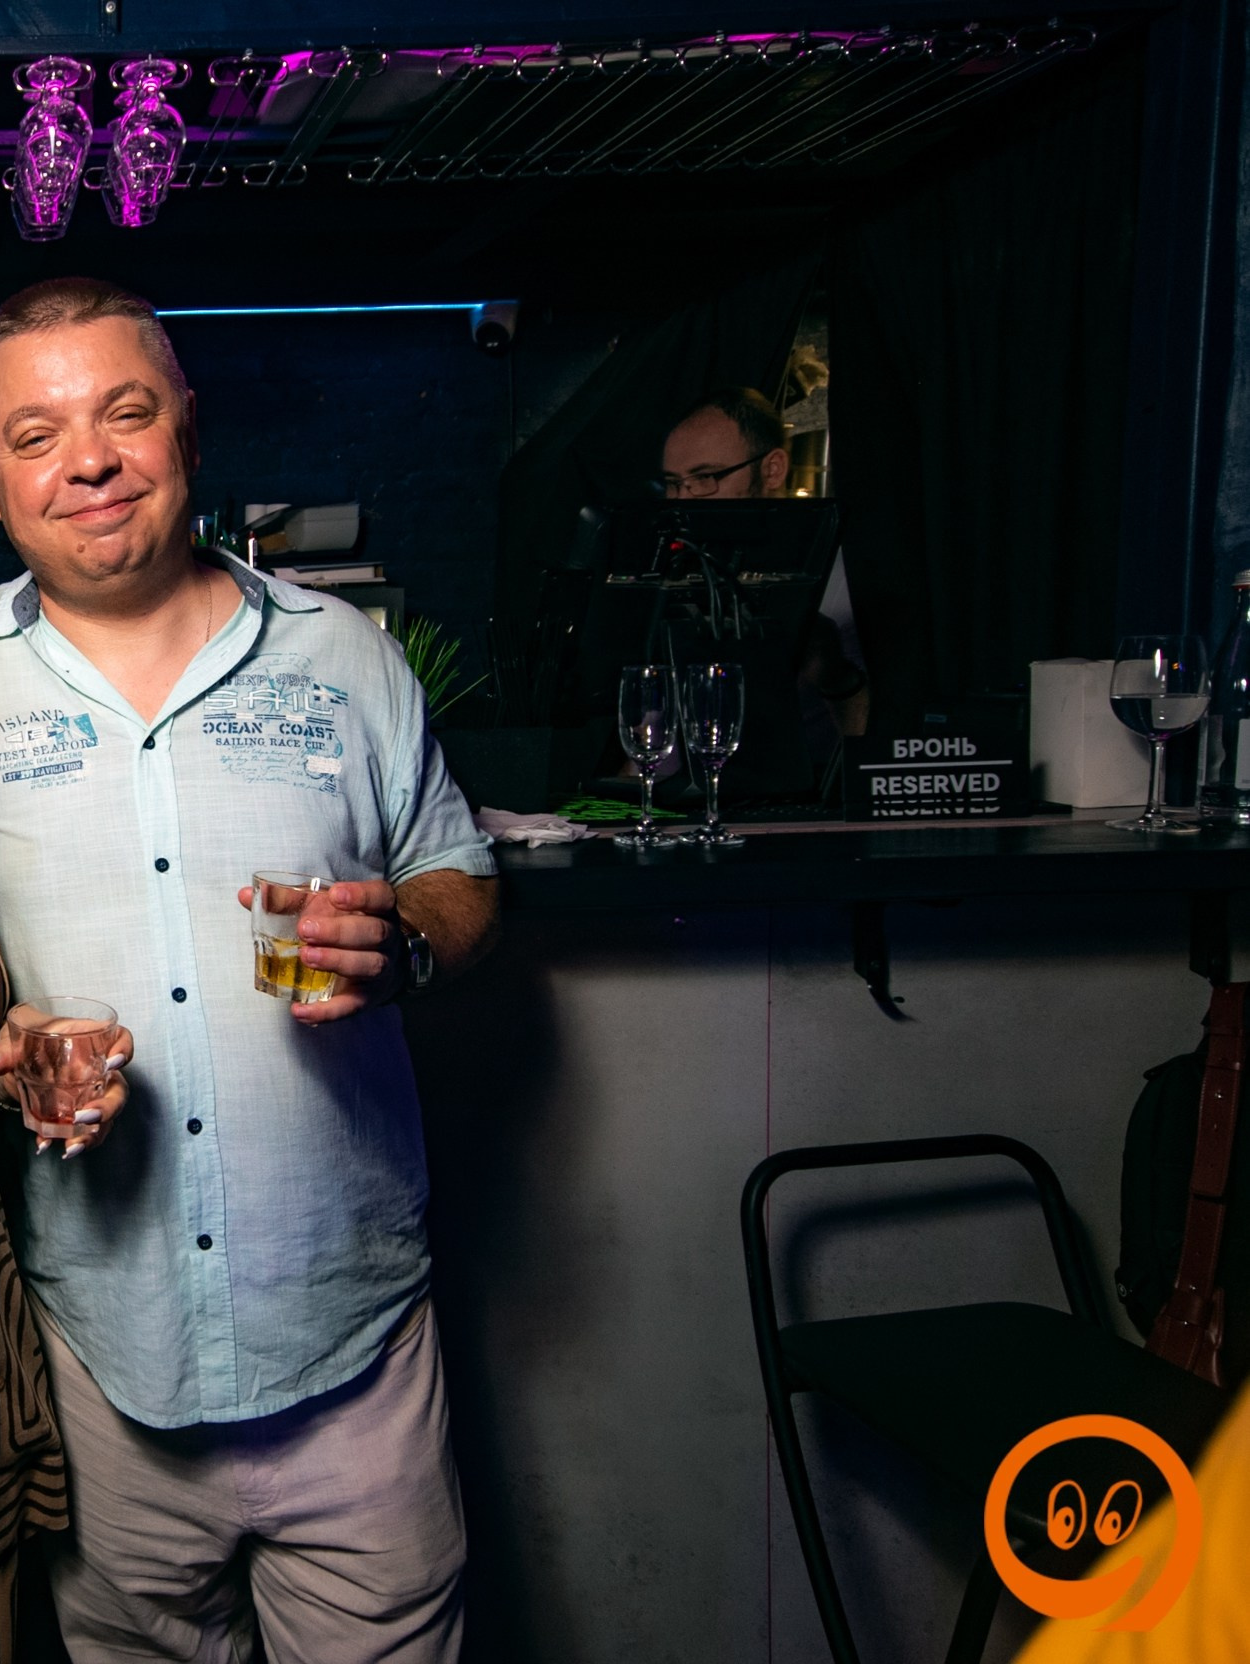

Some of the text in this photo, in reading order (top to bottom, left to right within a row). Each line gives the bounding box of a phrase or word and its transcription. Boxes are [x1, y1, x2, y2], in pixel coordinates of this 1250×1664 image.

[203, 688, 335, 717] SAIL
[0, 709, 64, 732] ISLAND
[202, 721, 336, 741] OCEAN COAST
[33, 738, 97, 756] SEAPORT
[215, 737, 266, 748] SAILING
[269, 738, 302, 749] RACE
[892, 737, 978, 759] БРОНЬ
[871, 772, 1001, 796] RESERVED
